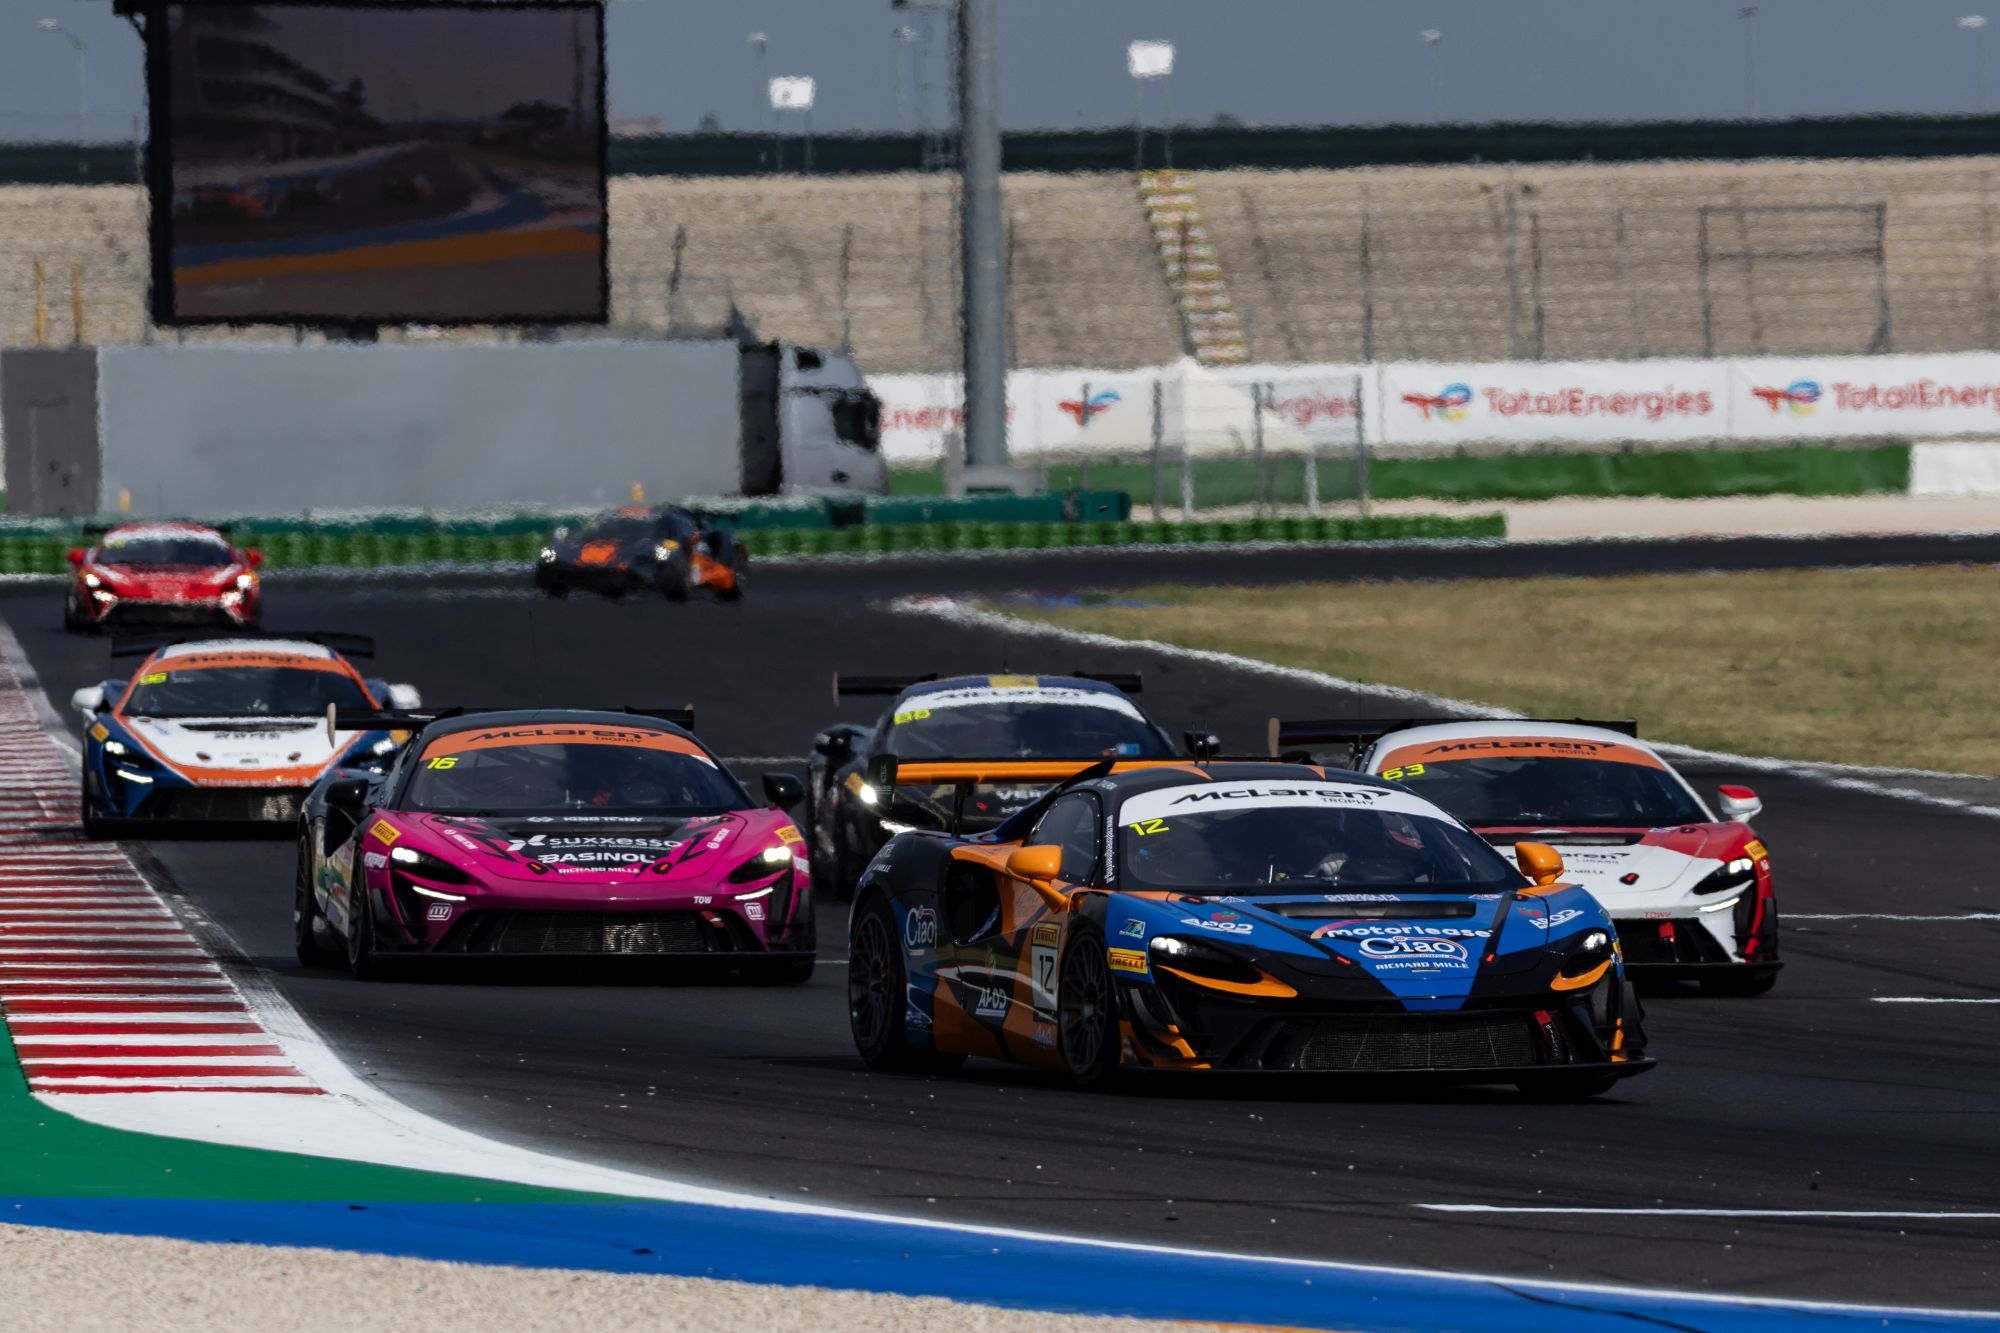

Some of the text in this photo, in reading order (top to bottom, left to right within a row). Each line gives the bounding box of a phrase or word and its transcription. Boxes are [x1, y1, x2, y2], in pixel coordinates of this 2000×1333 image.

[1482, 384, 1714, 421] TotalEnergies
[1831, 378, 2000, 413] TotalEner
[466, 728, 663, 743] McLaren
[593, 736, 642, 744] TROPHY
[1424, 741, 1617, 755] McLaren
[427, 757, 458, 770] 16
[1382, 764, 1425, 780] 63
[1169, 788, 1392, 806] McLaren
[1320, 797, 1375, 806] TROPHY
[1129, 818, 1170, 837] 12
[549, 836, 683, 848] suxxesso
[537, 852, 656, 864] BASINOL
[558, 866, 606, 874] RICHARD
[693, 896, 712, 904] TOW
[906, 907, 934, 946] Ciao
[1327, 925, 1494, 938] motorlease
[1360, 937, 1455, 954] Ciao
[1039, 954, 1055, 995] 12
